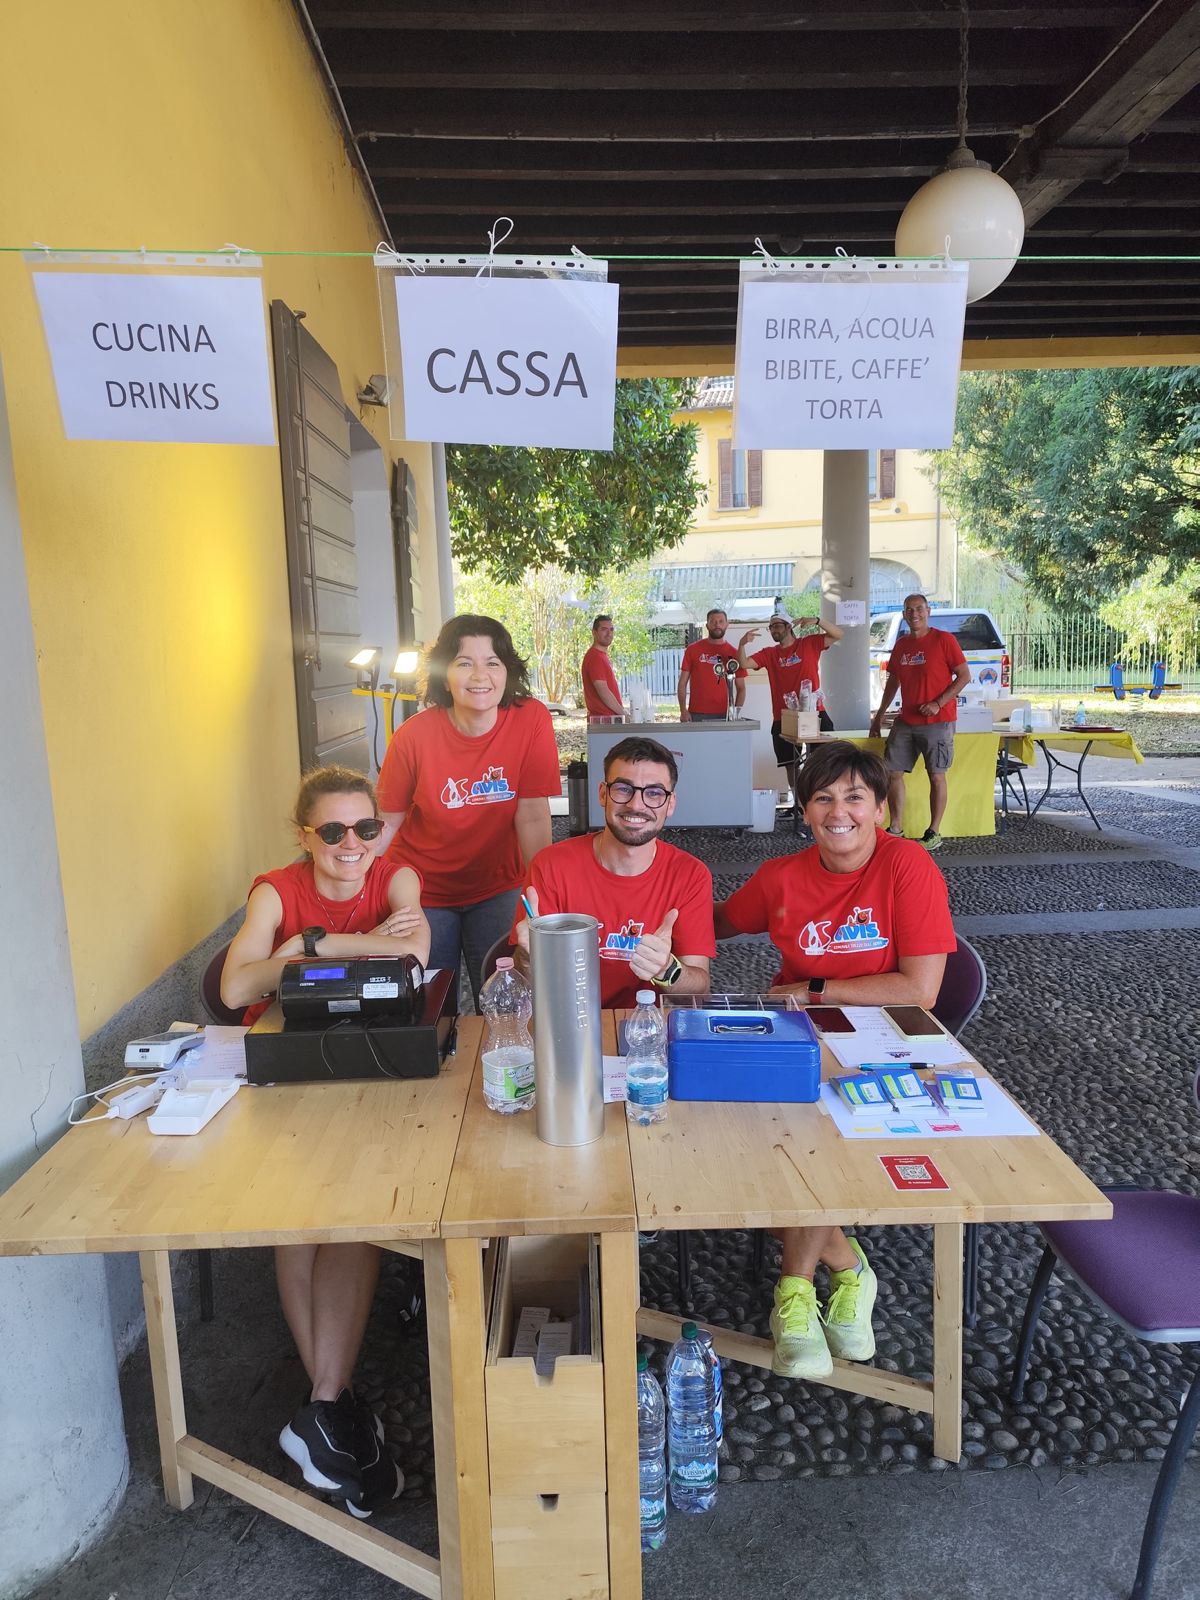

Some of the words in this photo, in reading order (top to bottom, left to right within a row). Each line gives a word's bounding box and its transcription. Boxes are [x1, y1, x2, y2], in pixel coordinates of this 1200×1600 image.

[92, 322, 217, 353] CUCINA
[765, 318, 840, 343] BIRRA,
[848, 317, 935, 342] ACQUA
[426, 347, 588, 398] CASSA
[765, 359, 843, 384] BIBITE,
[105, 380, 220, 410] DRINKS
[805, 398, 883, 420] TORTA
[472, 779, 508, 795] AVIS
[834, 922, 879, 941] AVIS
